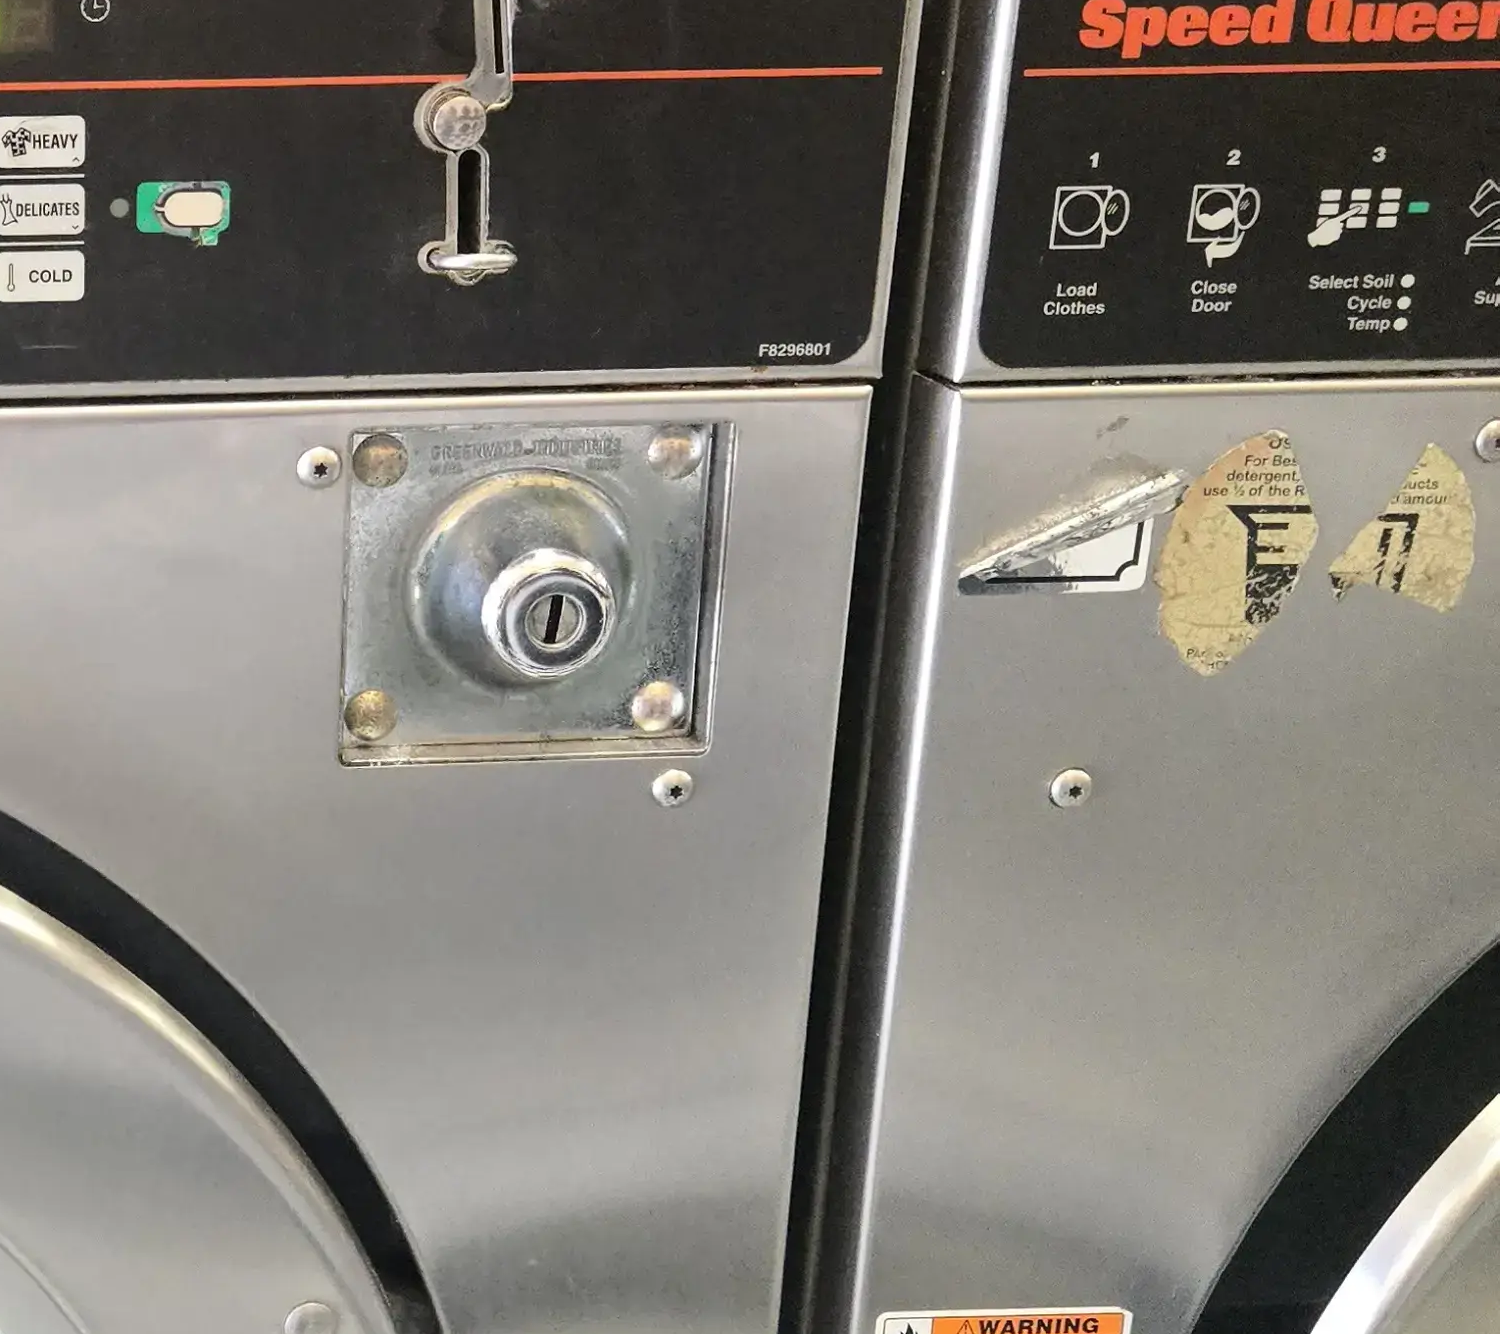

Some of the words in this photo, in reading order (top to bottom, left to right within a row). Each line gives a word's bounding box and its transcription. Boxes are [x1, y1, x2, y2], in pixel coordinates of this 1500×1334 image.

[32, 133, 78, 150] HEAVY
[1088, 151, 1101, 169] 1
[1226, 149, 1242, 166] 2
[1371, 146, 1388, 163] 3
[16, 202, 79, 218] DELICATES
[28, 269, 73, 284] COLD
[1307, 274, 1361, 290] Select
[1362, 273, 1394, 289] Soil
[1056, 281, 1098, 298] Load
[1190, 279, 1238, 296] Close
[1042, 299, 1106, 316] Clothes
[1190, 297, 1232, 313] Door
[1346, 294, 1392, 312] Cycle
[1346, 315, 1391, 333] Temp
[759, 343, 831, 357] F8296801
[1244, 455, 1268, 466] For
[1203, 487, 1228, 496] use
[1249, 485, 1263, 496] of
[1269, 485, 1290, 496] the
